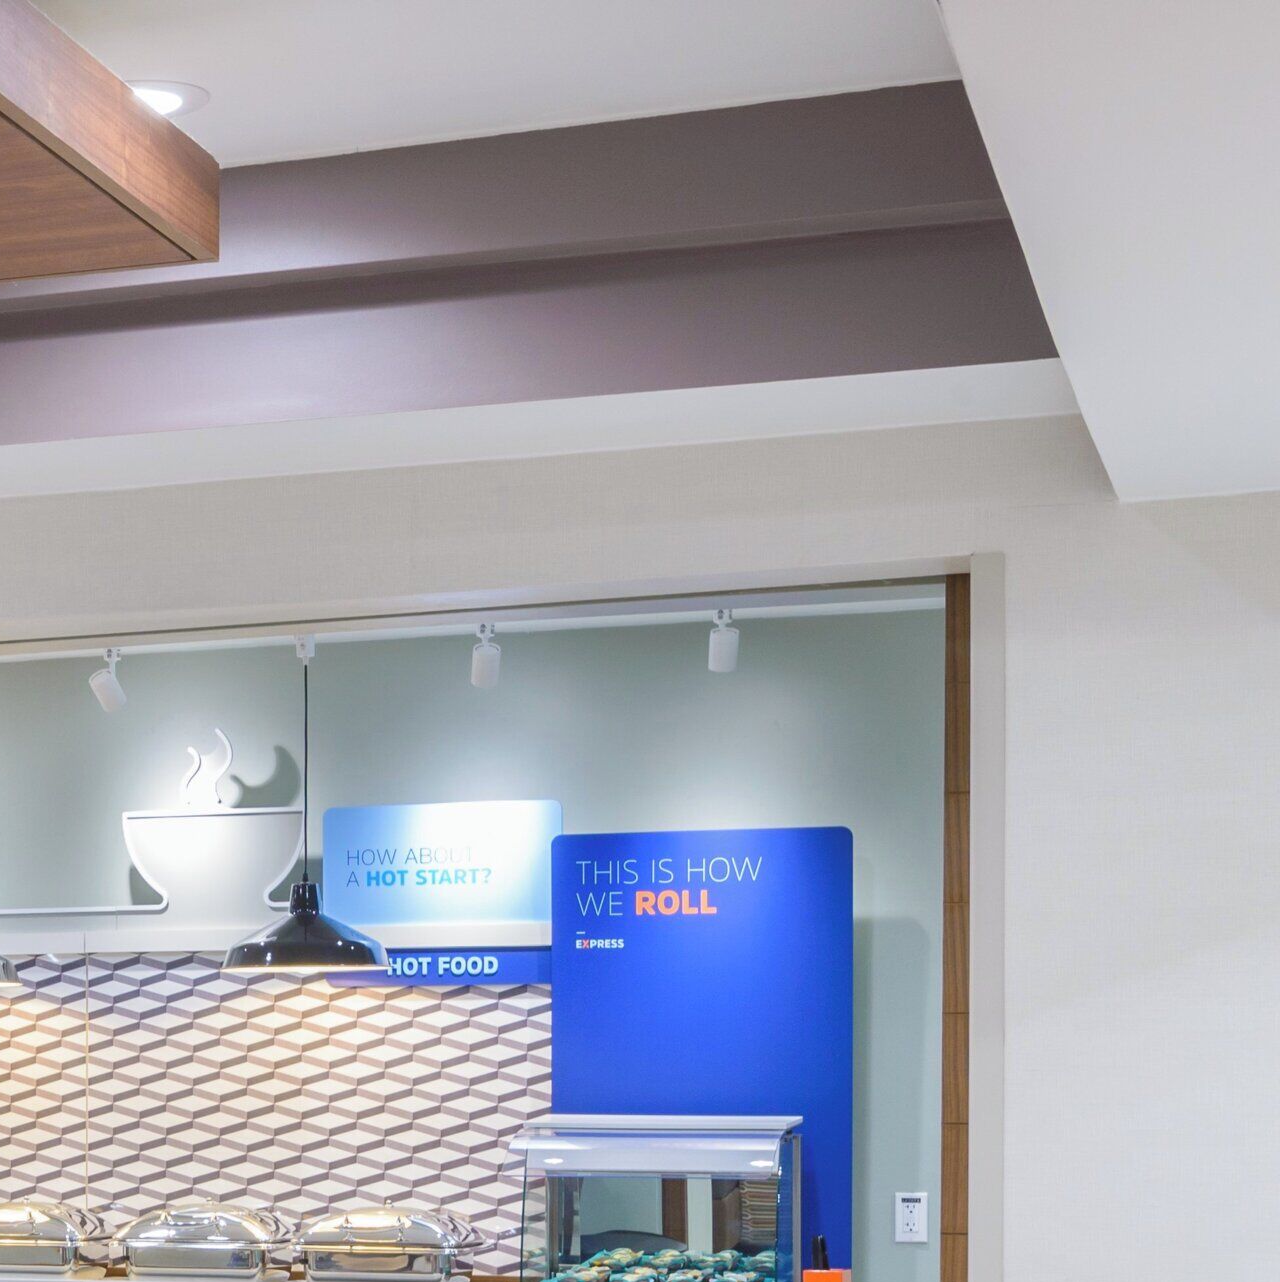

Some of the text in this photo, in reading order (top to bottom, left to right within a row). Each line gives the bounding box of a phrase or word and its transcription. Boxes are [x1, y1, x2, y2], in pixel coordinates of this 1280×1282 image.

[346, 847, 472, 866] HOW ABOUT
[346, 867, 492, 887] A HOT START?
[576, 856, 763, 885] THIS IS HOW
[576, 889, 717, 917] WE ROLL
[576, 938, 624, 949] EXPRESS
[387, 956, 499, 976] HOT FOOD
